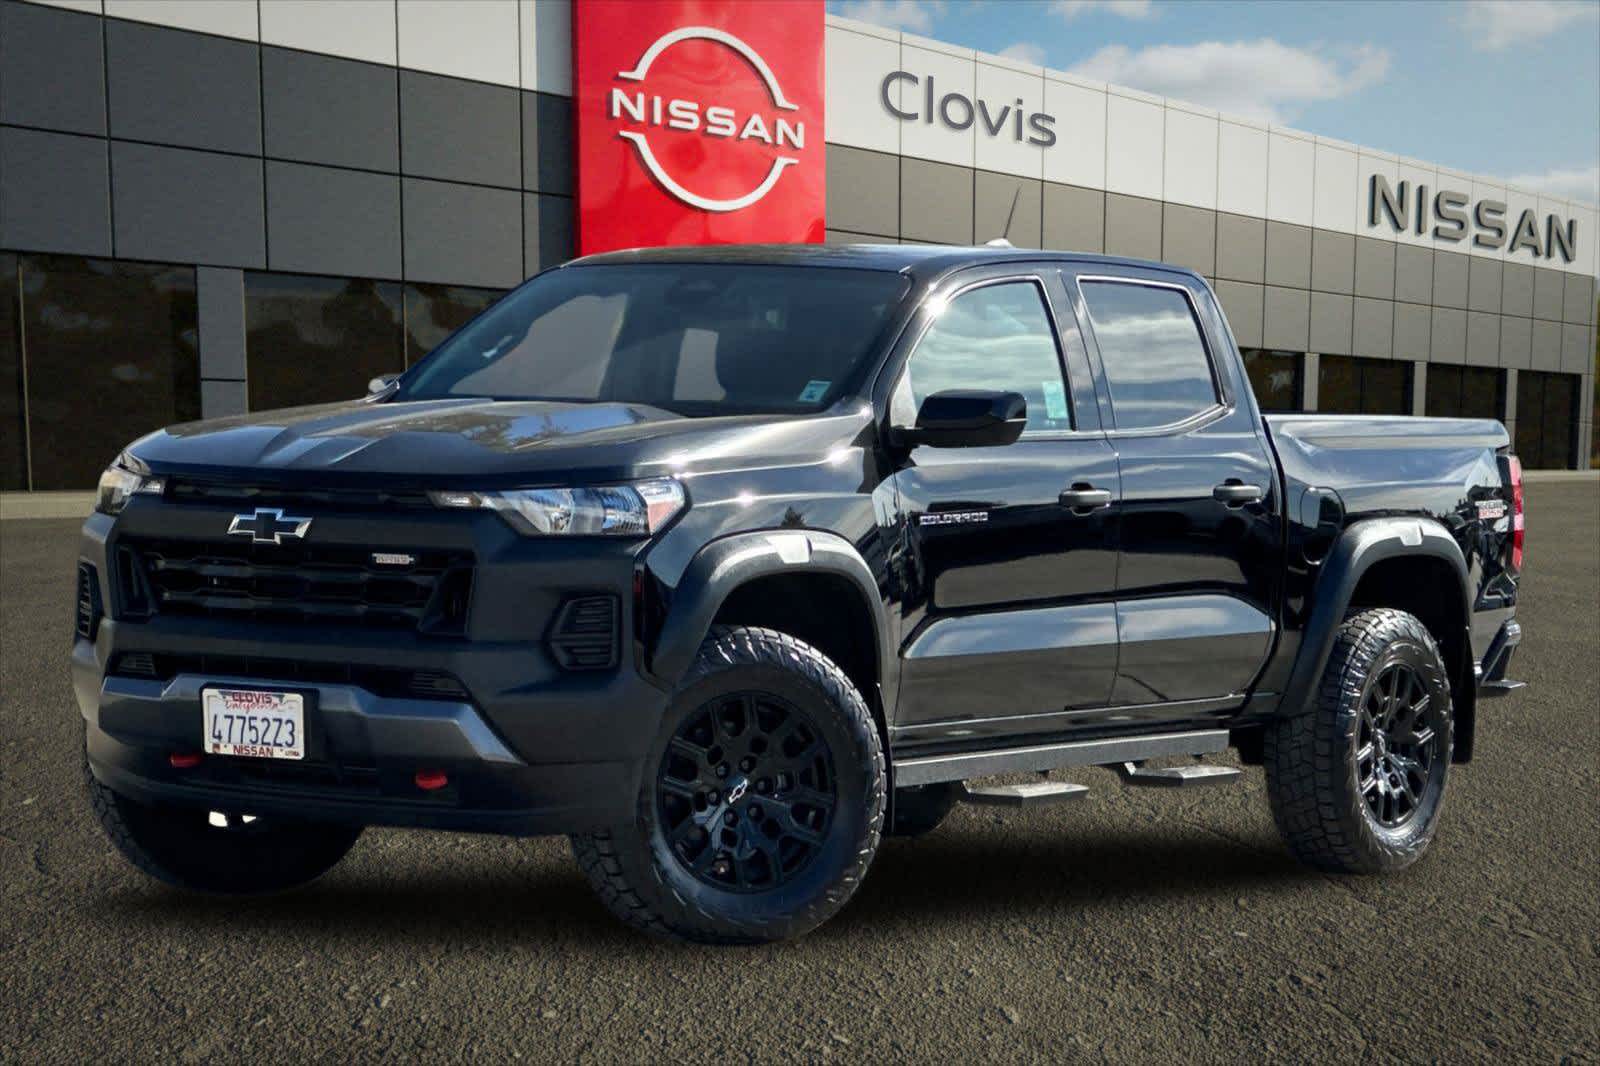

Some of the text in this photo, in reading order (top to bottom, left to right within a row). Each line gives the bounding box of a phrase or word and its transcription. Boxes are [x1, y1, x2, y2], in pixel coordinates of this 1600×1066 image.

[610, 87, 805, 149] NISSAN
[881, 70, 1057, 147] Clovis
[1368, 173, 1577, 263] NISSAN
[919, 511, 988, 525] COLORADO
[232, 691, 273, 704] CLOVIS
[212, 713, 295, 748] 47752Z3
[233, 744, 274, 757] NISSAN
